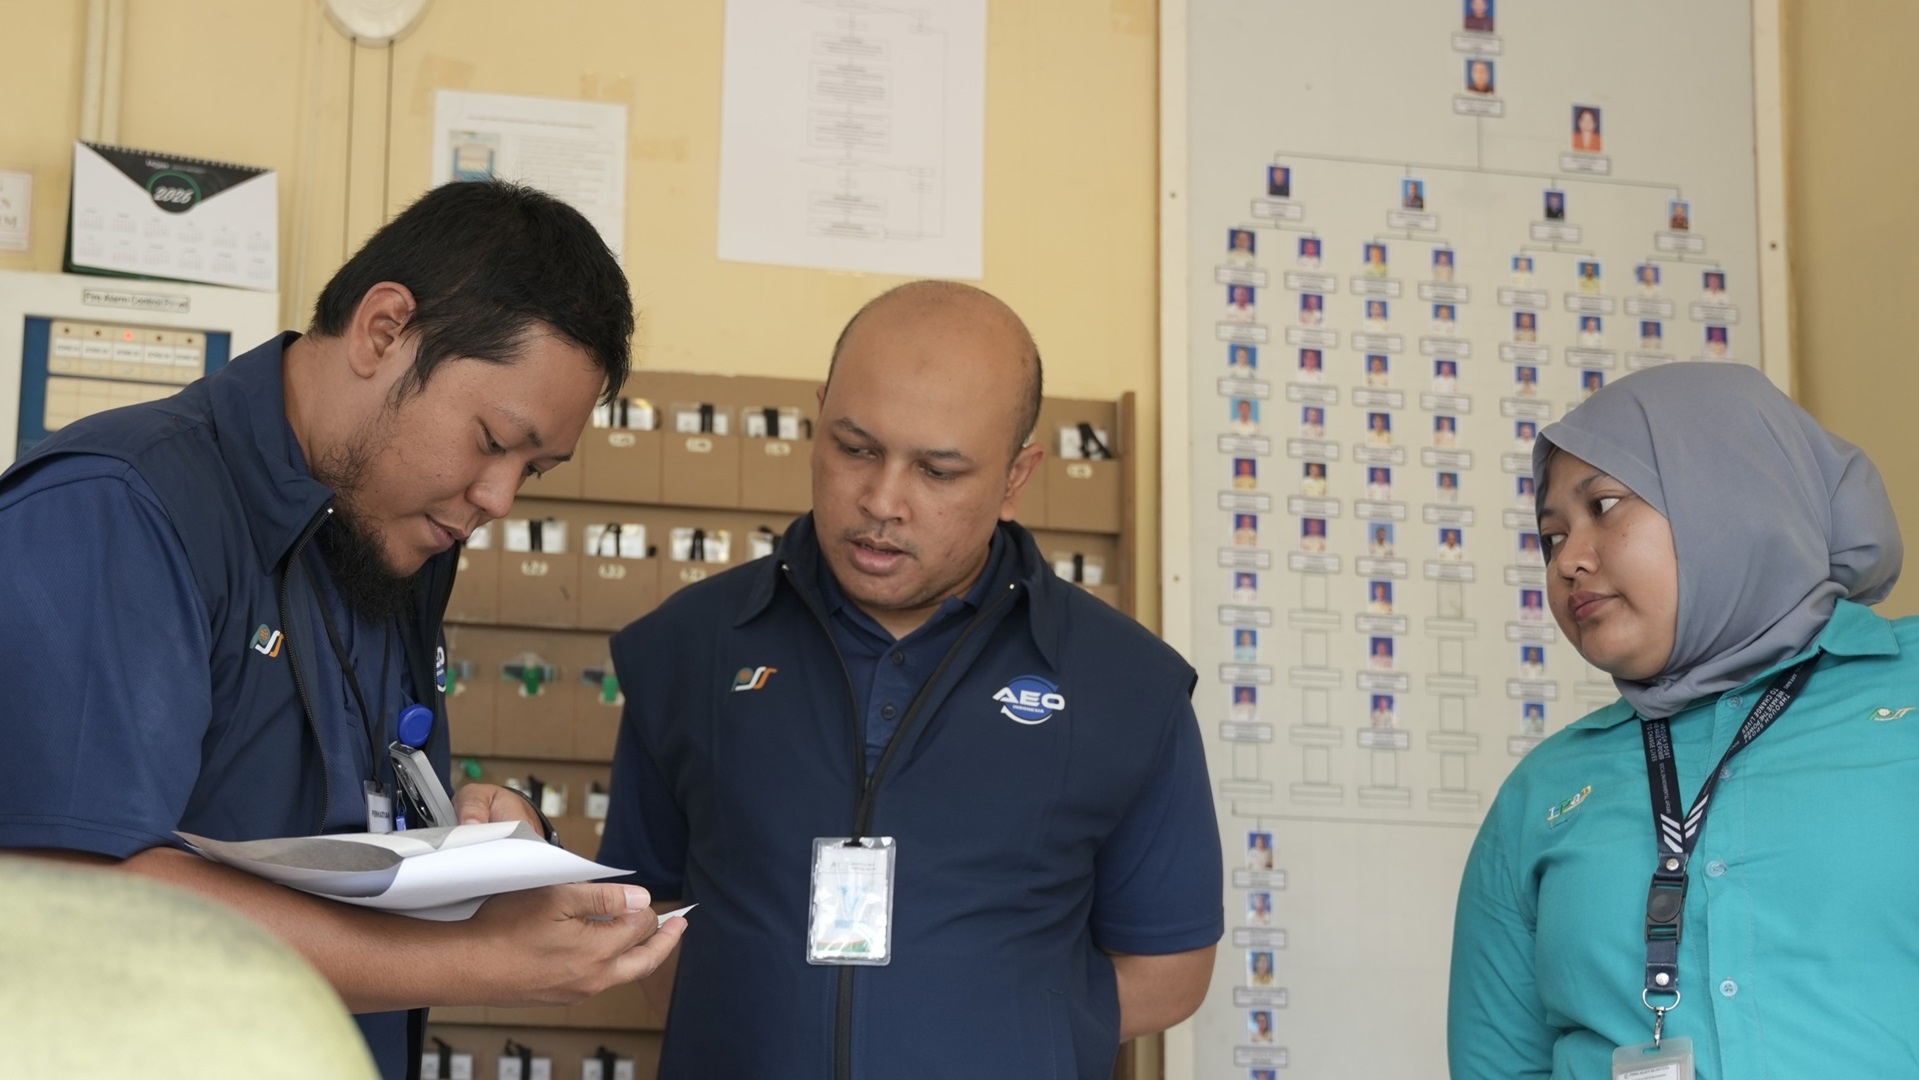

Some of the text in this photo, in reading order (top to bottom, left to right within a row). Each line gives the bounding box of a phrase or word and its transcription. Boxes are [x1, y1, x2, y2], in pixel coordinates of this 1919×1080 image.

[154, 186, 194, 204] 2026
[992, 687, 1065, 711] AEO
[1012, 704, 1045, 714] INDONESIA
[1753, 695, 1772, 718] CHANGE
[1766, 698, 1779, 712] HAVE
[1764, 695, 1790, 724] THROUGH
